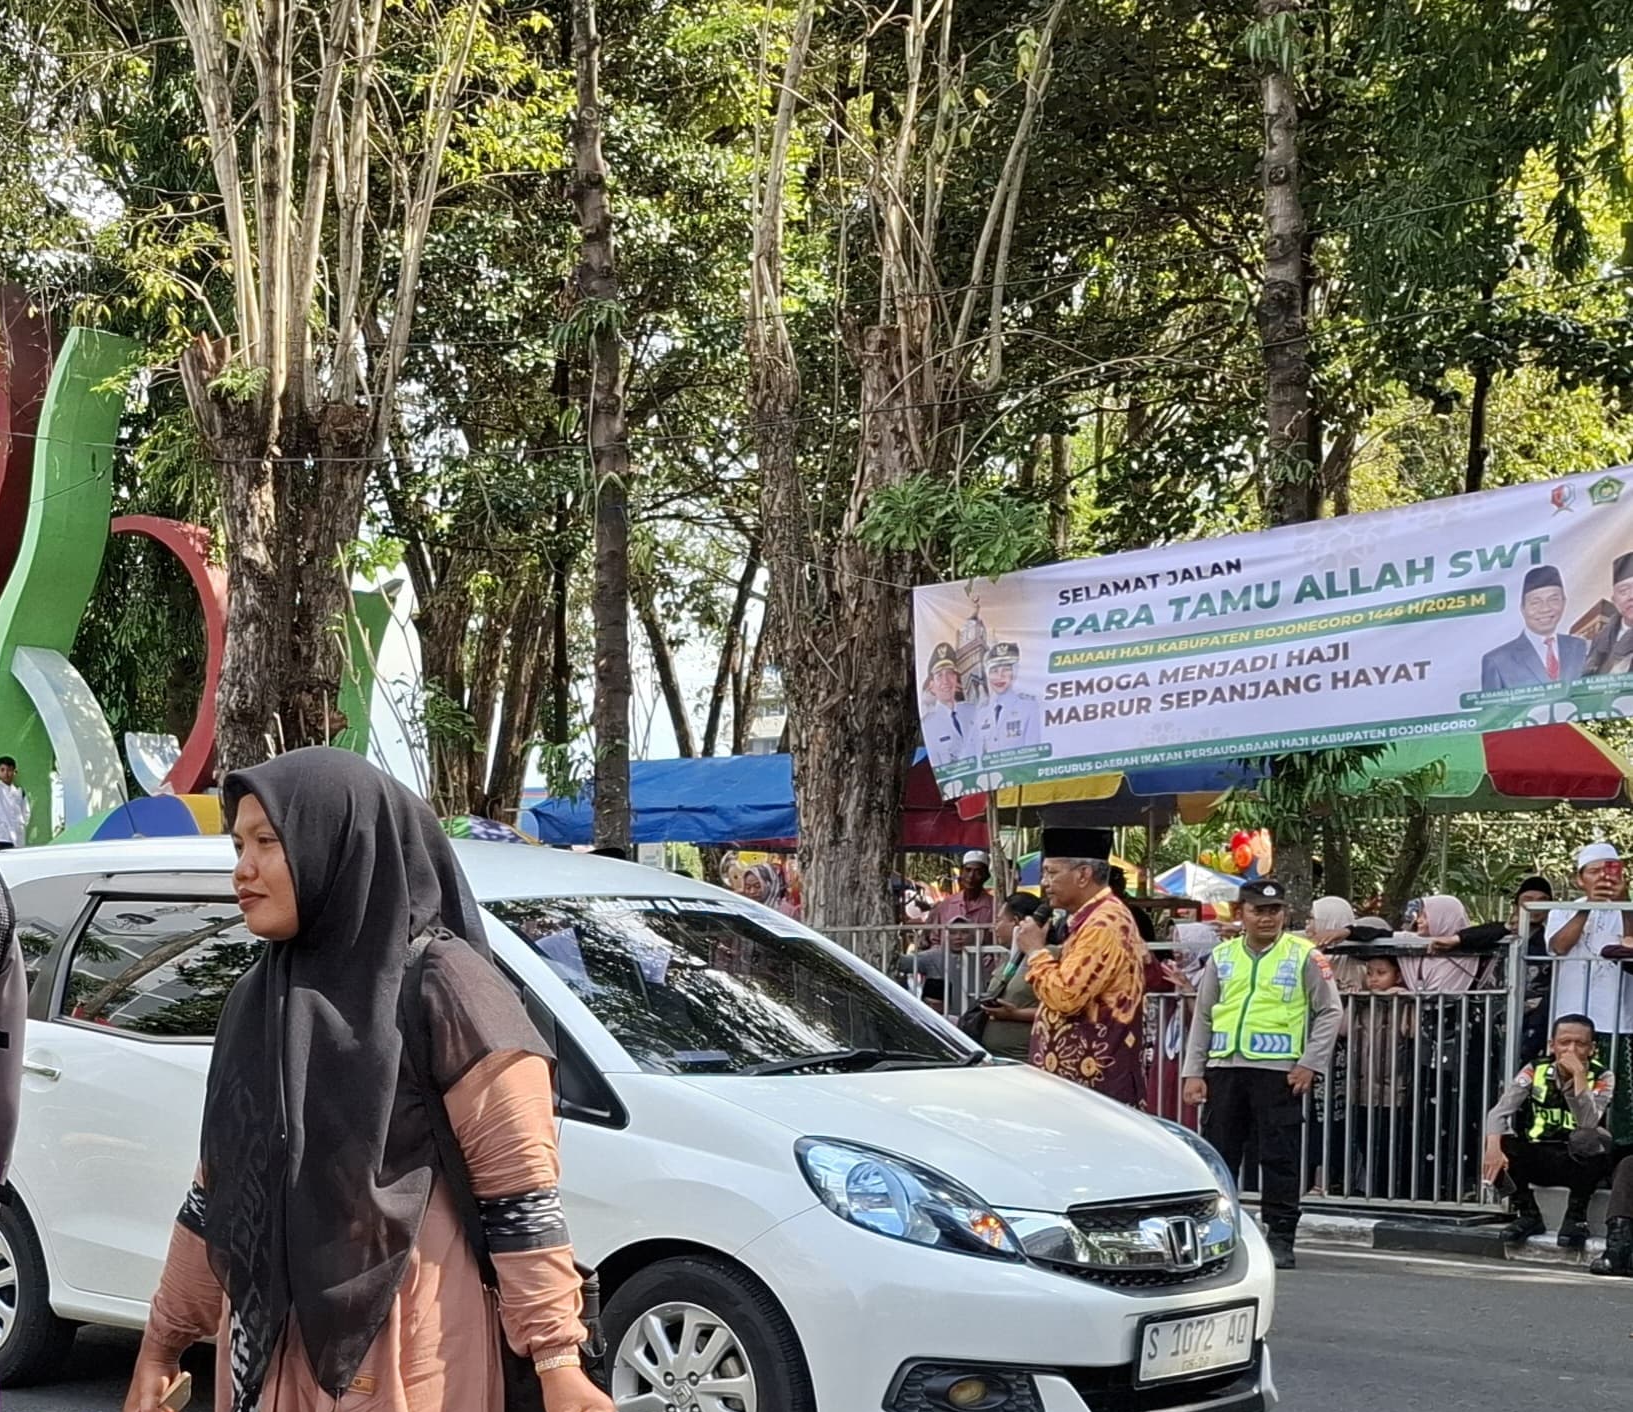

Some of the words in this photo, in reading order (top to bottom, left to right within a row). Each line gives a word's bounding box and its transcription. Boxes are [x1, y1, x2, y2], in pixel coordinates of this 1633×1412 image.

[1050, 603, 1156, 639] PARA
[1168, 578, 1281, 623] TAMU
[1293, 555, 1435, 605] ALLAH
[1447, 534, 1551, 579] SWT
[1057, 573, 1160, 606] SELAMAT
[1166, 557, 1243, 586] JALAN
[1053, 648, 1117, 667] JAMAAH
[1119, 644, 1154, 659] HAJI
[1156, 631, 1250, 654] KABUPATEN
[1254, 613, 1364, 640] BOJONEGORO
[1367, 605, 1404, 621] 1446
[1407, 594, 1466, 616] H/2025
[1470, 592, 1487, 607] M
[1044, 671, 1151, 701] SEMOGA
[1157, 653, 1277, 686] MENJADI
[1285, 641, 1351, 668] HAJI
[1044, 697, 1153, 727] MABRUR
[1159, 674, 1322, 712] SEPANJANG
[1330, 660, 1432, 691] HAYAT
[1037, 761, 1093, 778] PENGURUS
[1095, 756, 1140, 771] DAERAH
[1140, 750, 1182, 765] IKATAN
[1184, 739, 1279, 761] PERSAUDARAAN
[1281, 736, 1308, 749] HAJI
[1311, 728, 1387, 745] KABUPATEN
[1389, 718, 1478, 737] BOJONEGORO
[1147, 1327, 1160, 1360] S
[1170, 1318, 1215, 1357] 1072
